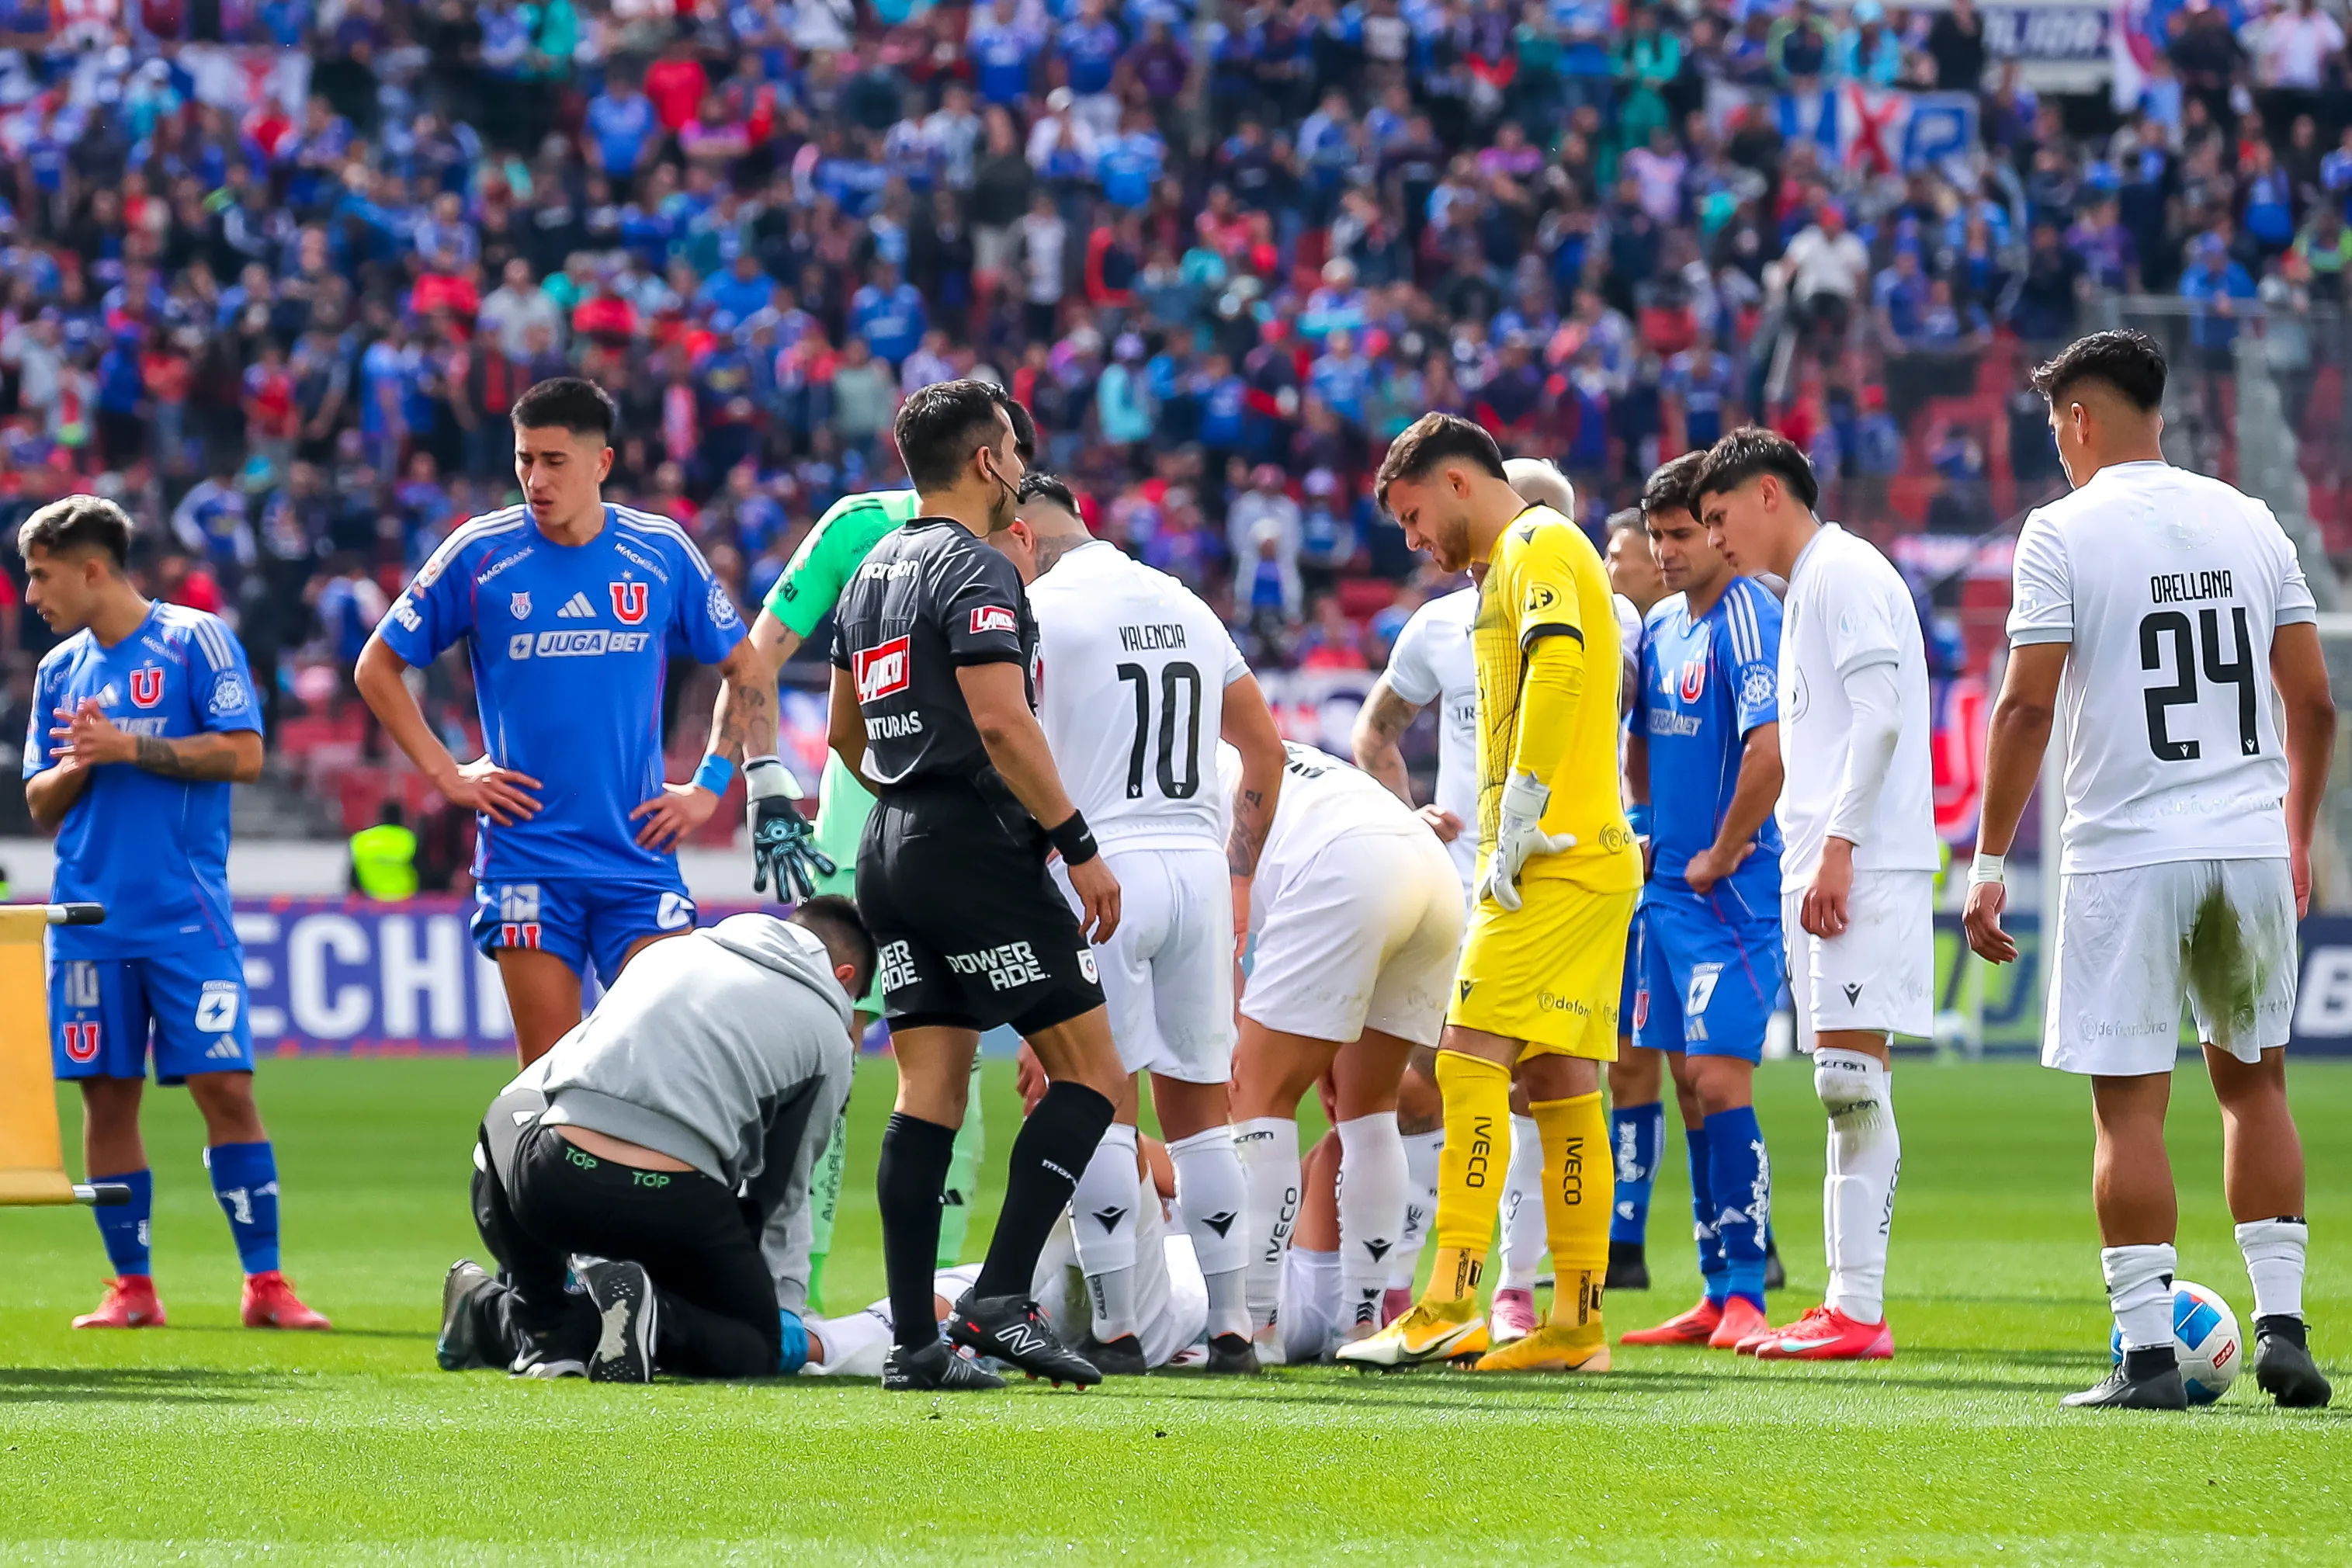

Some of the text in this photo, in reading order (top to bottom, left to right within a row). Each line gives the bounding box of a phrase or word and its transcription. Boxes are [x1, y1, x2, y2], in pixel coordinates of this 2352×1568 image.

[2150, 570, 2233, 603] ORELLANA
[539, 630, 650, 655] JUGABET
[1119, 624, 1187, 652] VALENCIA
[2139, 607, 2260, 761] 24
[1116, 661, 1202, 800] 10
[945, 940, 1036, 973] POWER
[565, 1147, 597, 1170] TOP
[1466, 1116, 1493, 1188] IVECO
[1563, 1136, 1584, 1206] IVECO
[633, 1171, 670, 1188] TOP
[1878, 1157, 1902, 1235] IVECO
[1265, 1187, 1297, 1262] IVECO
